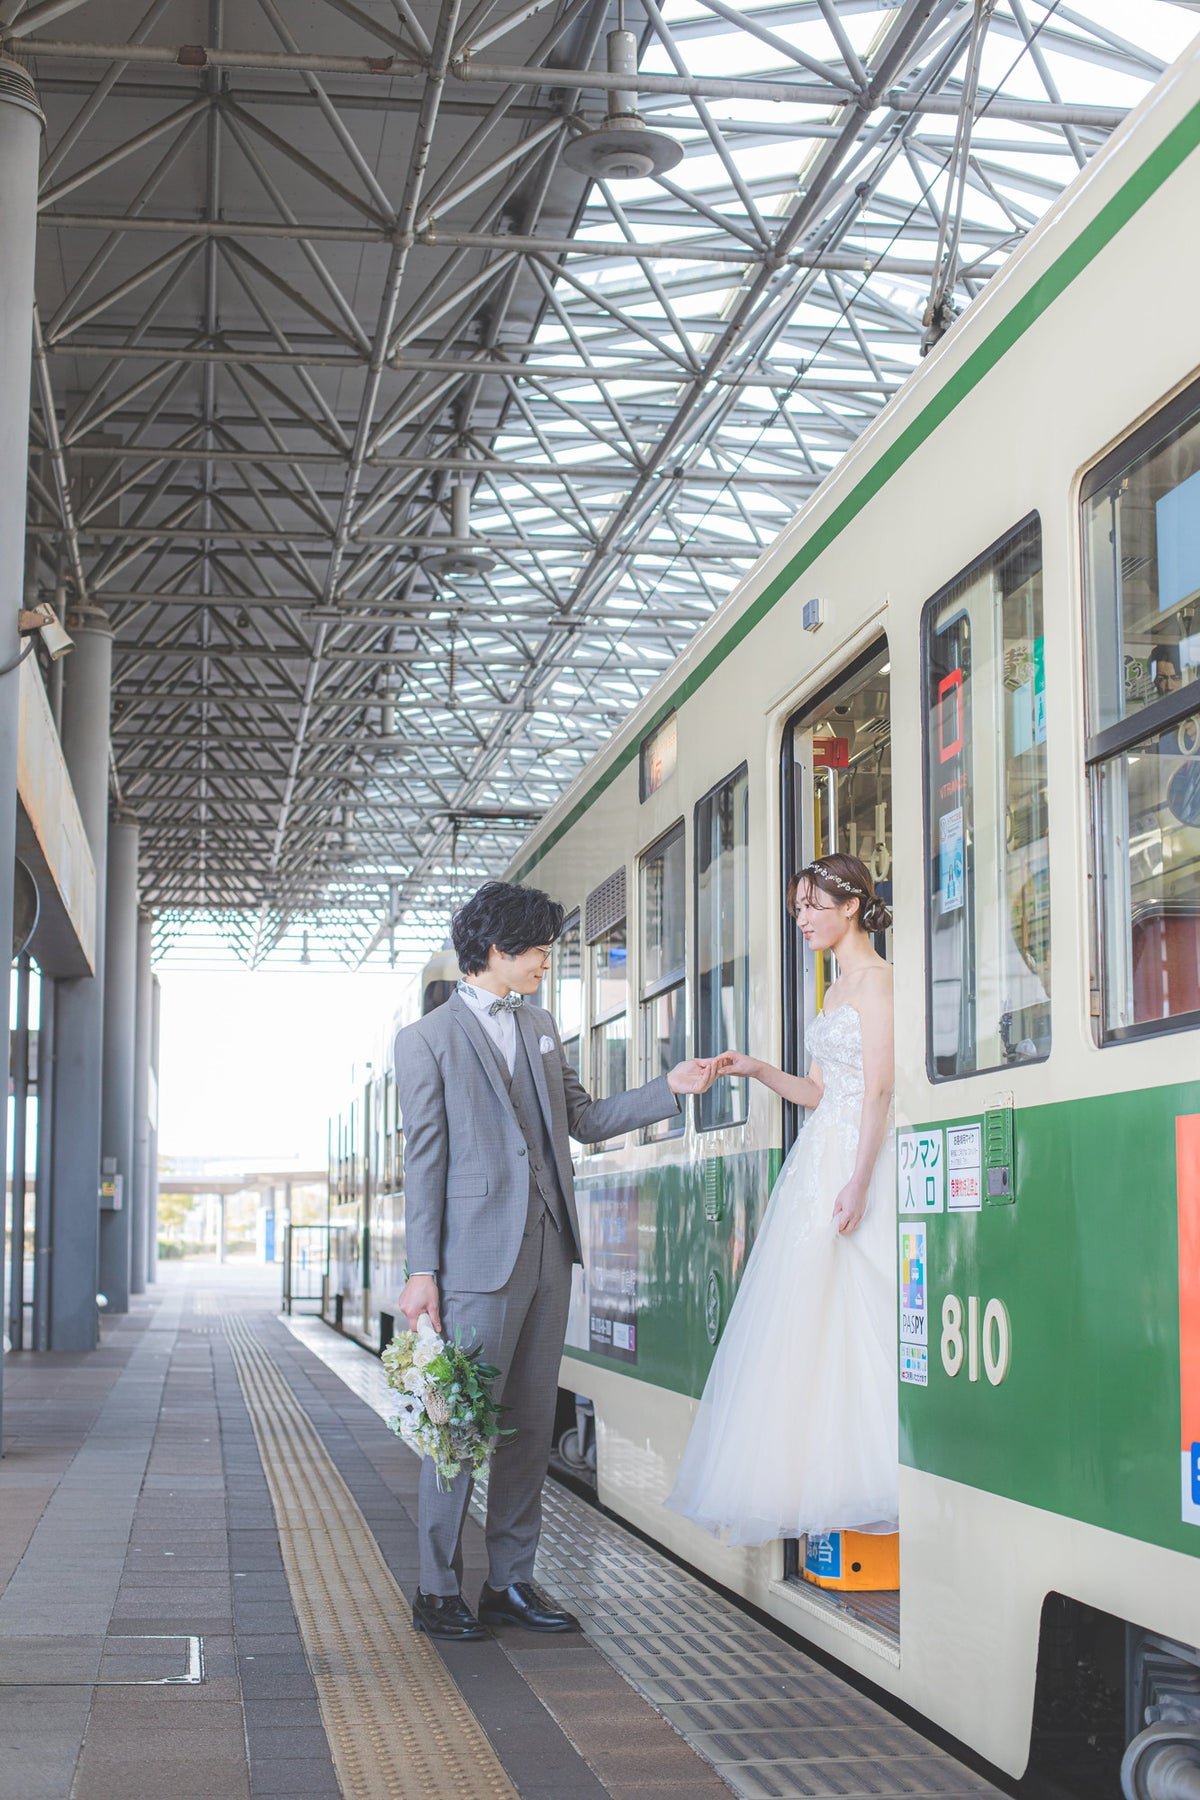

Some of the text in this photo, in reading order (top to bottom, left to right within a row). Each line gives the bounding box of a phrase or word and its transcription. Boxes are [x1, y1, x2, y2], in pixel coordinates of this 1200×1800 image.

[900, 1138, 941, 1170] ワンマン
[904, 1175, 936, 1208] 入口
[902, 1313, 925, 1336] PASPY
[940, 1293, 1009, 1387] 810
